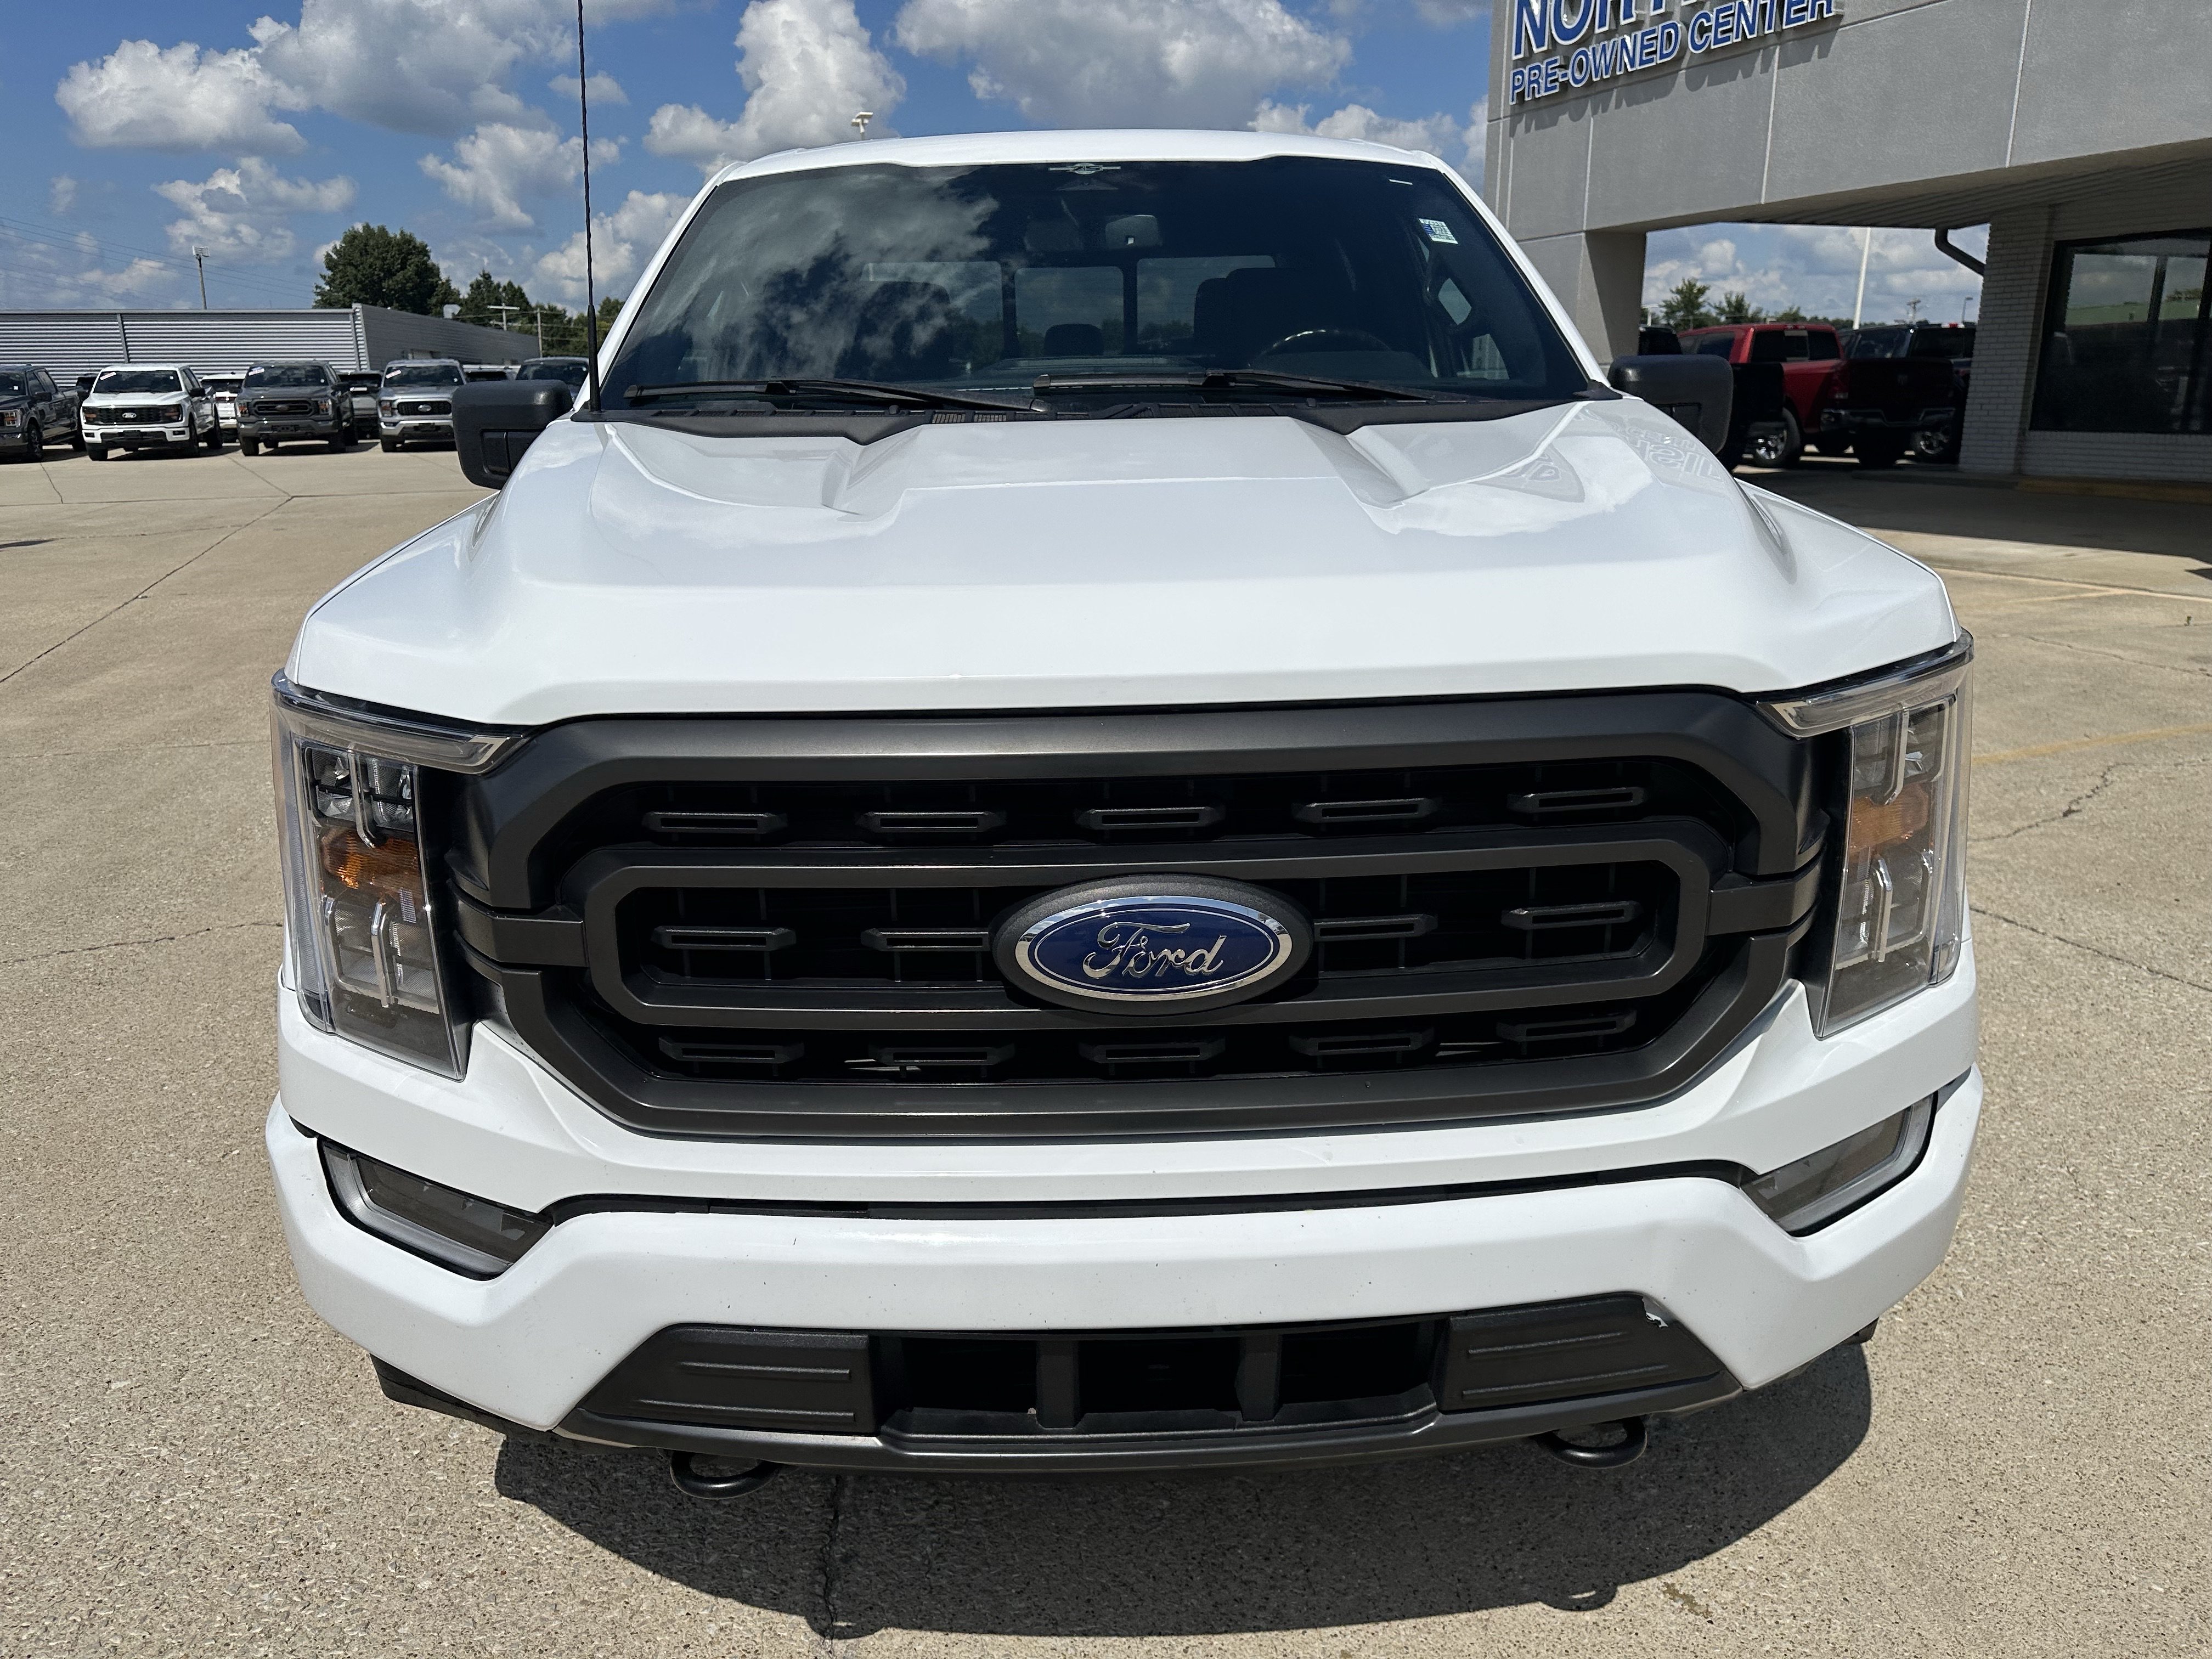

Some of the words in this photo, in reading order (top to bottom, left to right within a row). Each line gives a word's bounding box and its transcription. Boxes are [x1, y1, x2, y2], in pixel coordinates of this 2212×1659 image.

[1509, 20, 1681, 105] PRE-OWNED
[1688, 0, 1834, 54] CENTER
[1082, 922, 1228, 979] Ford
